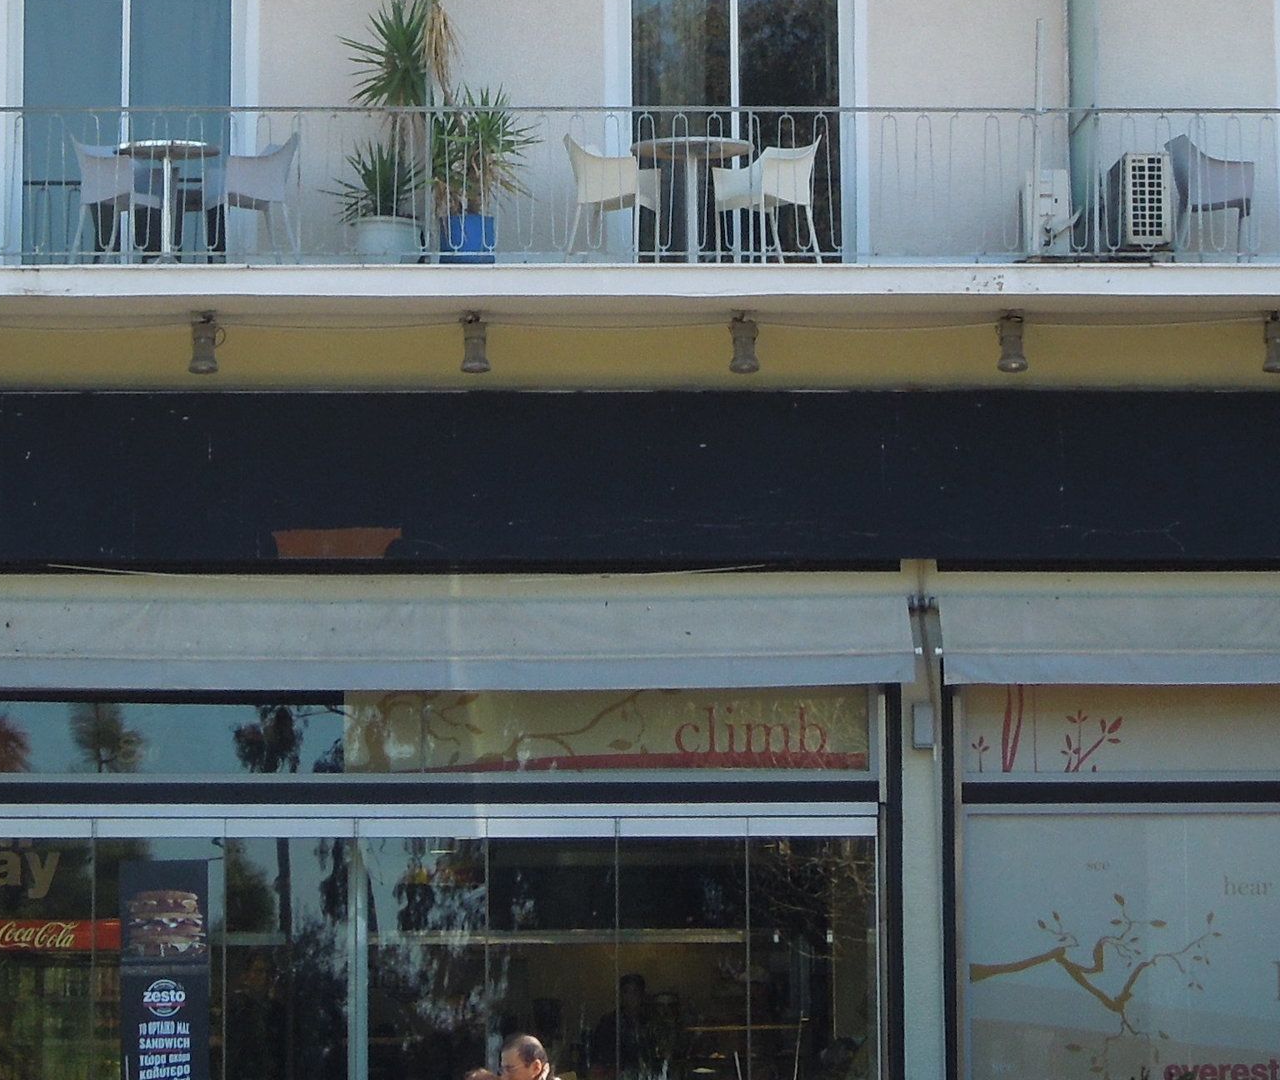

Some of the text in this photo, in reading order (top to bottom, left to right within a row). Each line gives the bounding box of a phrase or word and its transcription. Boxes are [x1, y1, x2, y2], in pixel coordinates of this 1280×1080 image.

[675, 704, 828, 753] climb
[1224, 876, 1273, 897] hear
[143, 990, 186, 1002] zesto
[139, 1037, 190, 1049] SANDWICH
